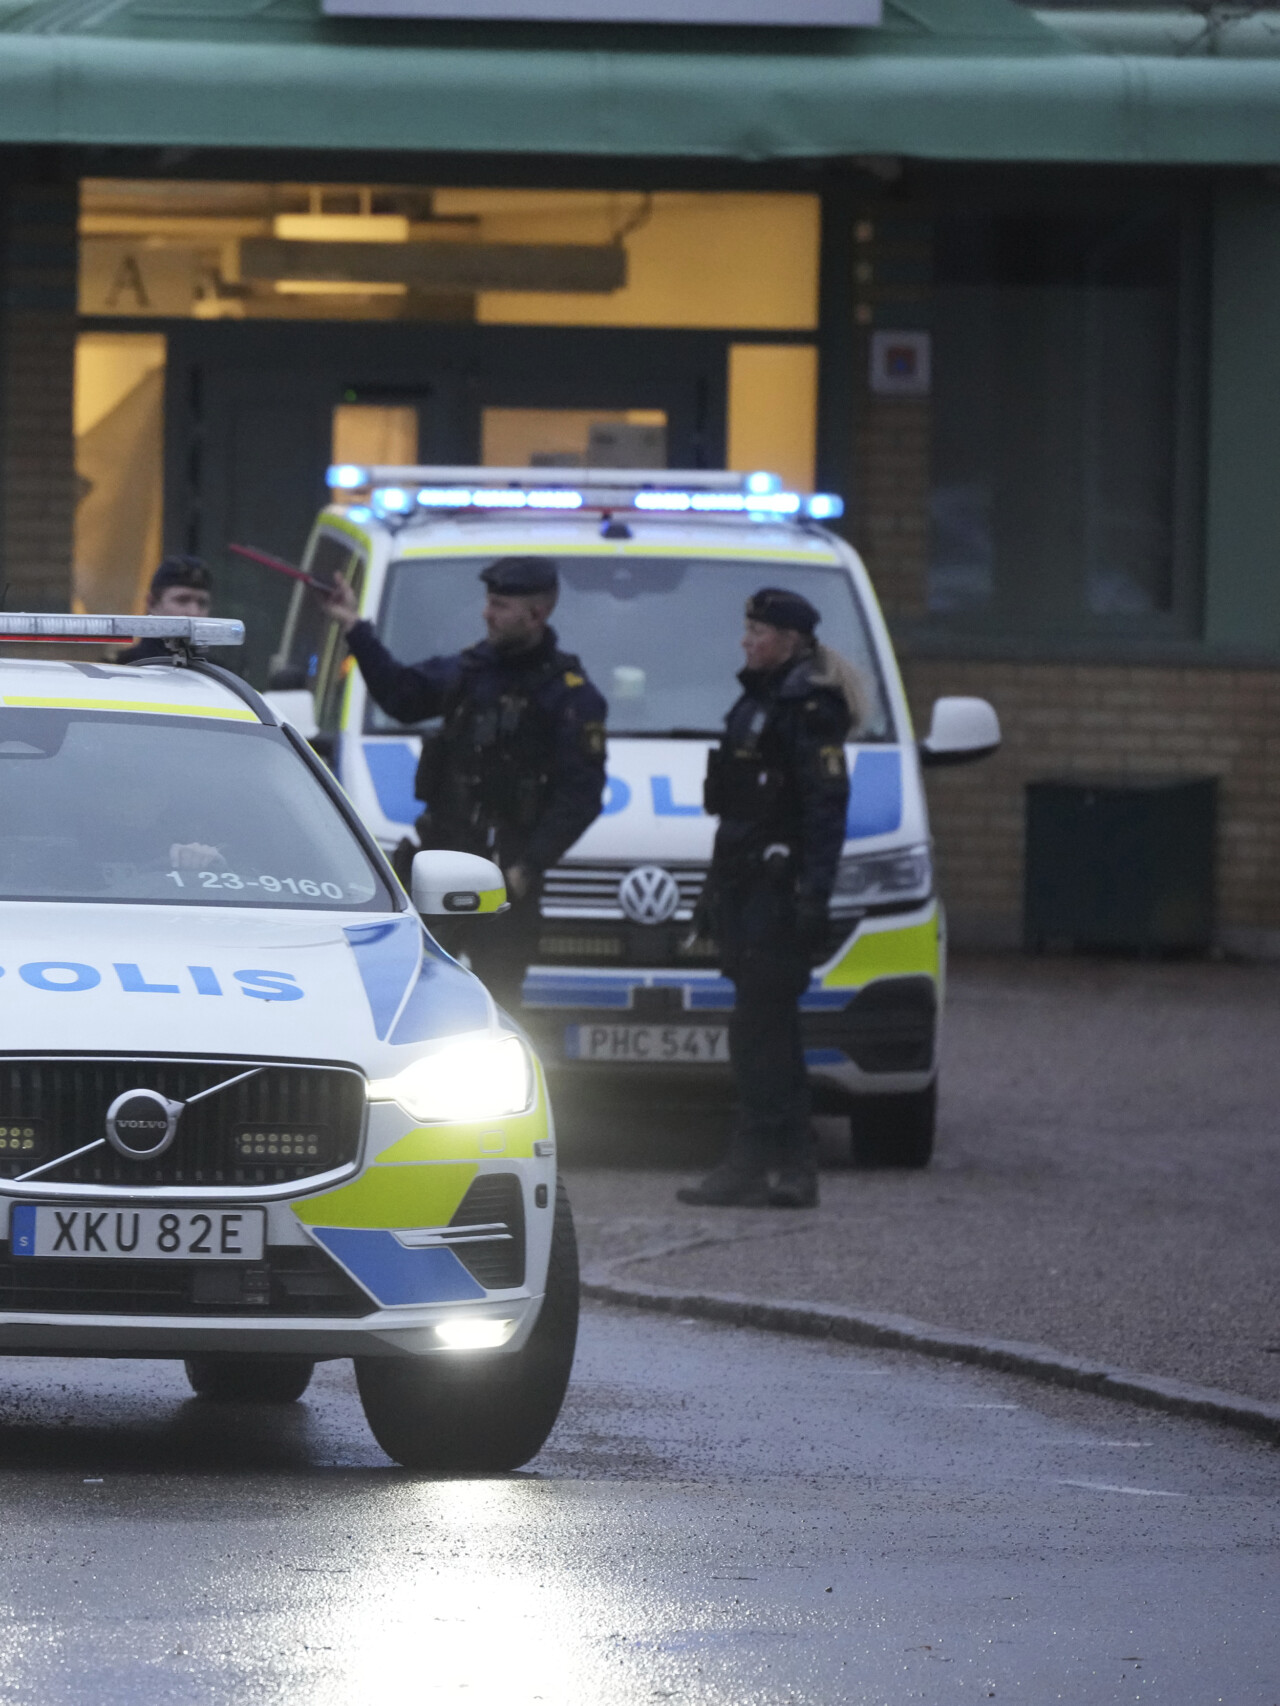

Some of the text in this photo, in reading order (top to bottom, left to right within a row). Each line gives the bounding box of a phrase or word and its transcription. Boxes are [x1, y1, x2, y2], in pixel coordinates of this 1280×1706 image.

[165, 871, 344, 899] 1 23-9160
[590, 1028, 723, 1057] PHC 54Y
[117, 1120, 167, 1129] VOLVO
[20, 1236, 28, 1247] S
[52, 1211, 243, 1254] XKU 82E
